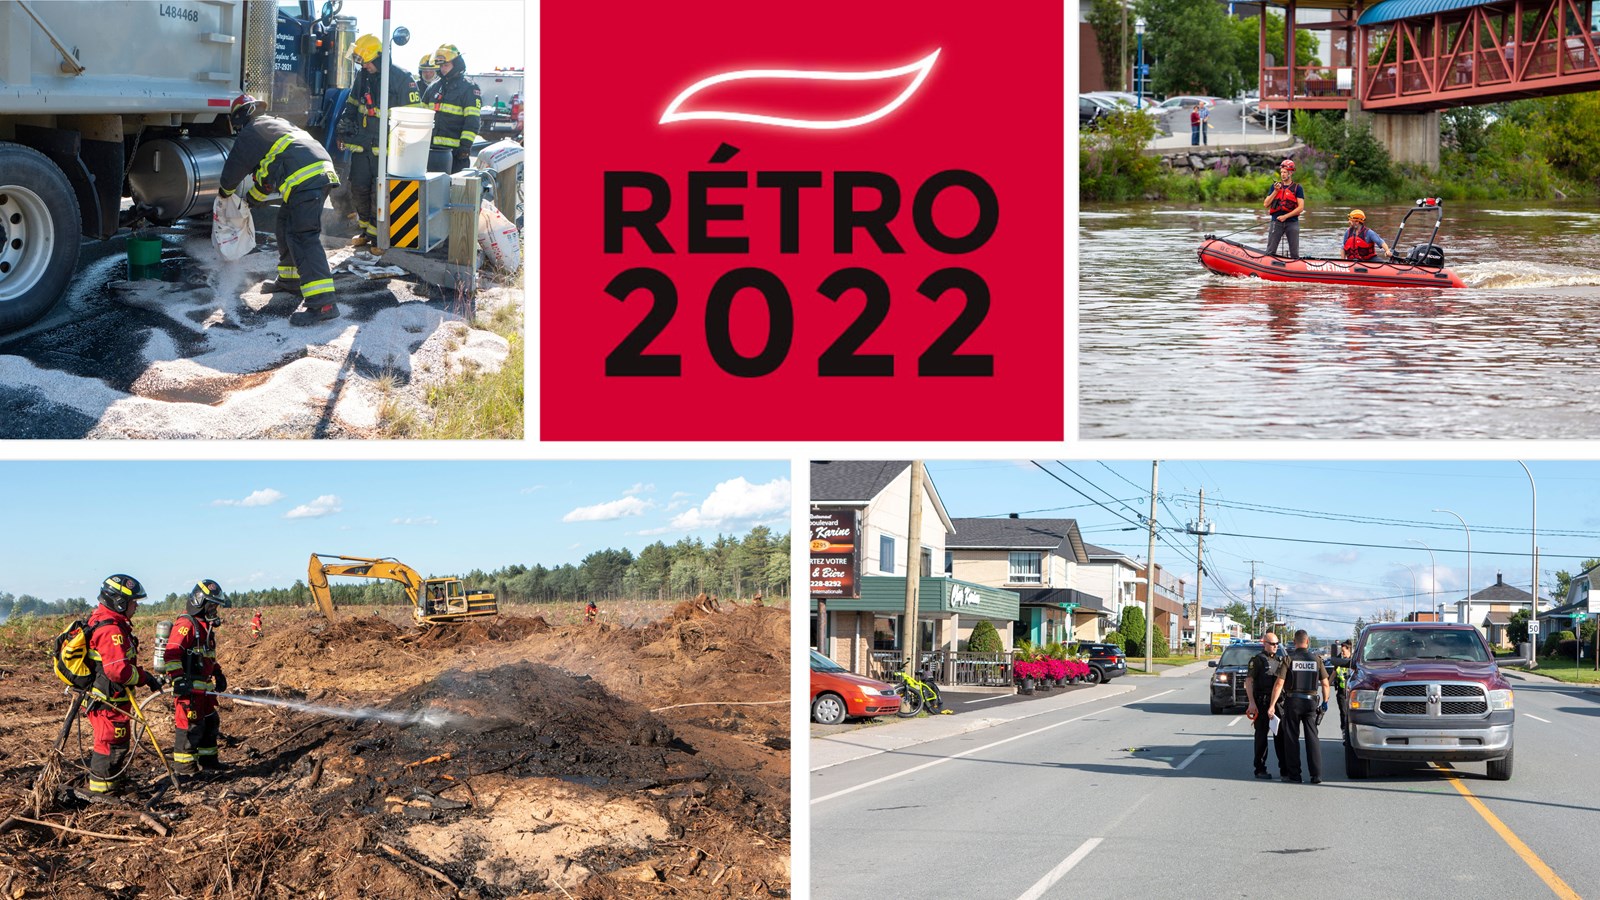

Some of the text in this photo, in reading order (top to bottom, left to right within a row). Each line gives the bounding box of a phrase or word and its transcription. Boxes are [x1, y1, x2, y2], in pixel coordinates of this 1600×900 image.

[160, 3, 199, 22] L484468
[409, 92, 420, 102] 06
[1306, 262, 1351, 273] SAUVETAGE
[815, 526, 851, 539] Karine
[811, 567, 845, 578] & Bière
[178, 626, 190, 637] 48
[1529, 624, 1539, 633] 50
[111, 634, 124, 646] 50
[1294, 662, 1315, 671] POLICE
[186, 710, 198, 720] 48
[114, 727, 127, 739] 50
